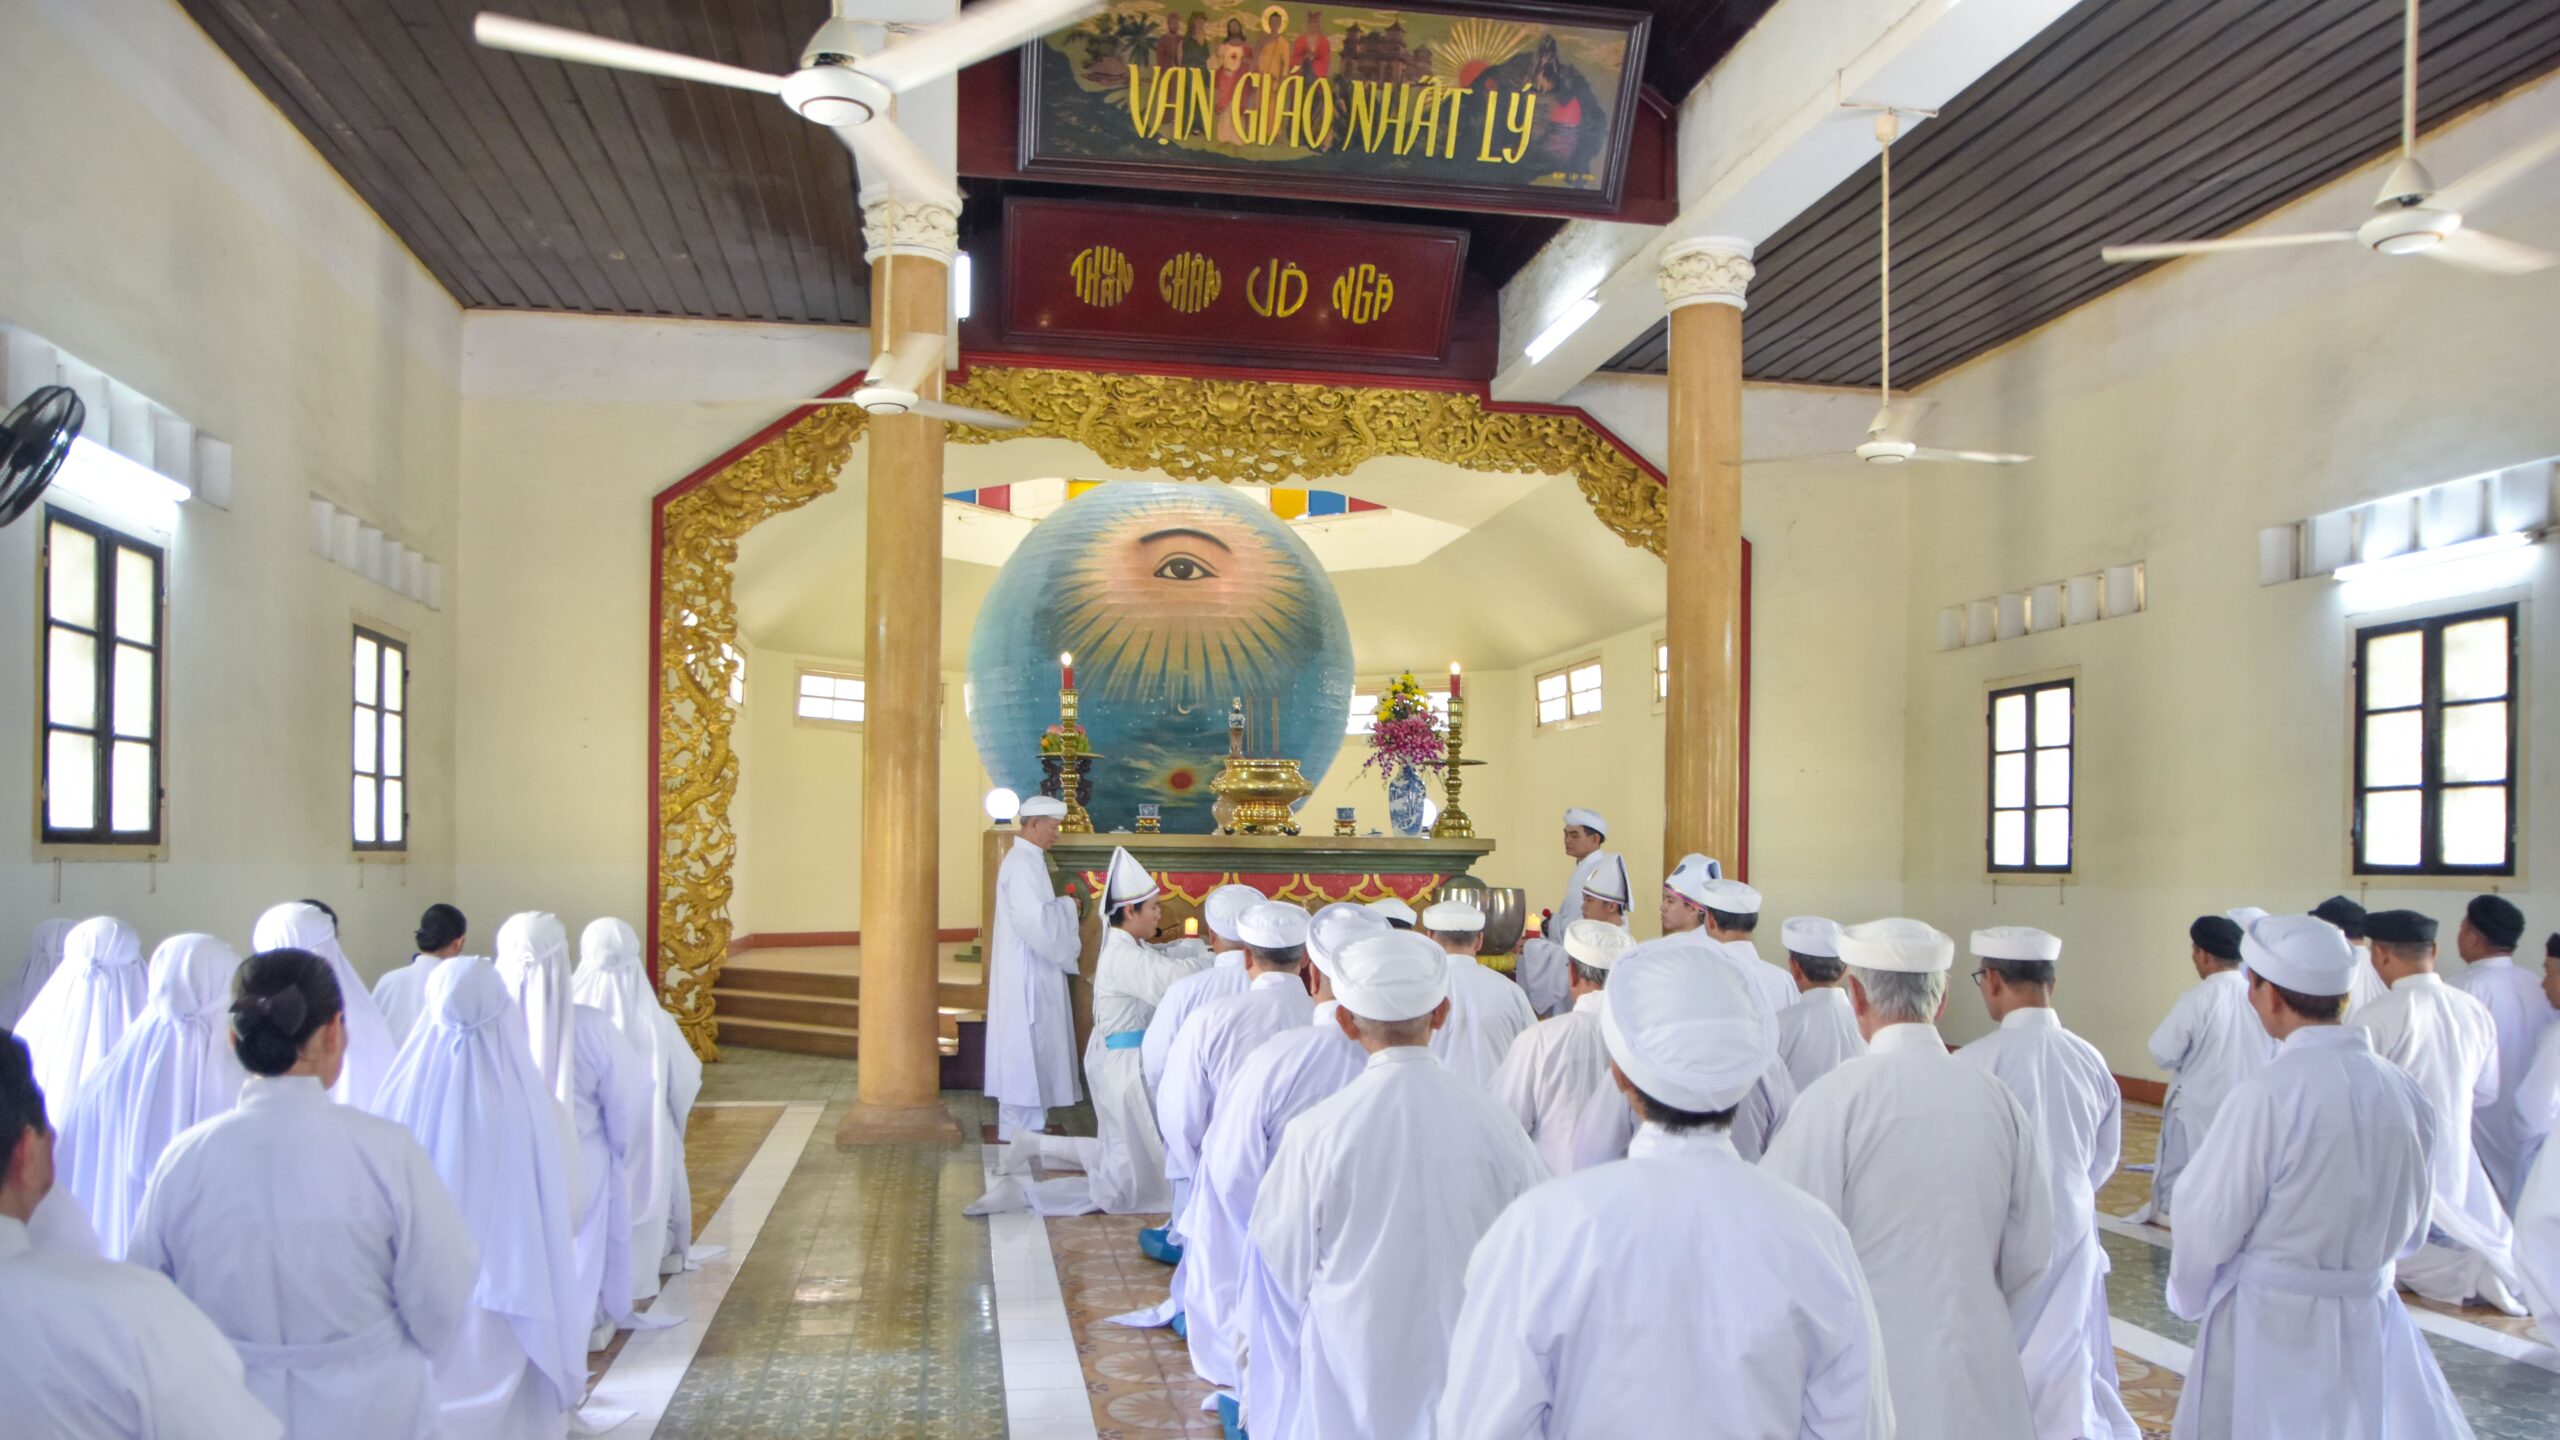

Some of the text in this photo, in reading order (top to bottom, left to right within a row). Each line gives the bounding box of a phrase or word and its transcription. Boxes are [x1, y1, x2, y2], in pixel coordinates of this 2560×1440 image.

[1127, 64, 1536, 164] VẠN GIÁO NHẤT LÝ
